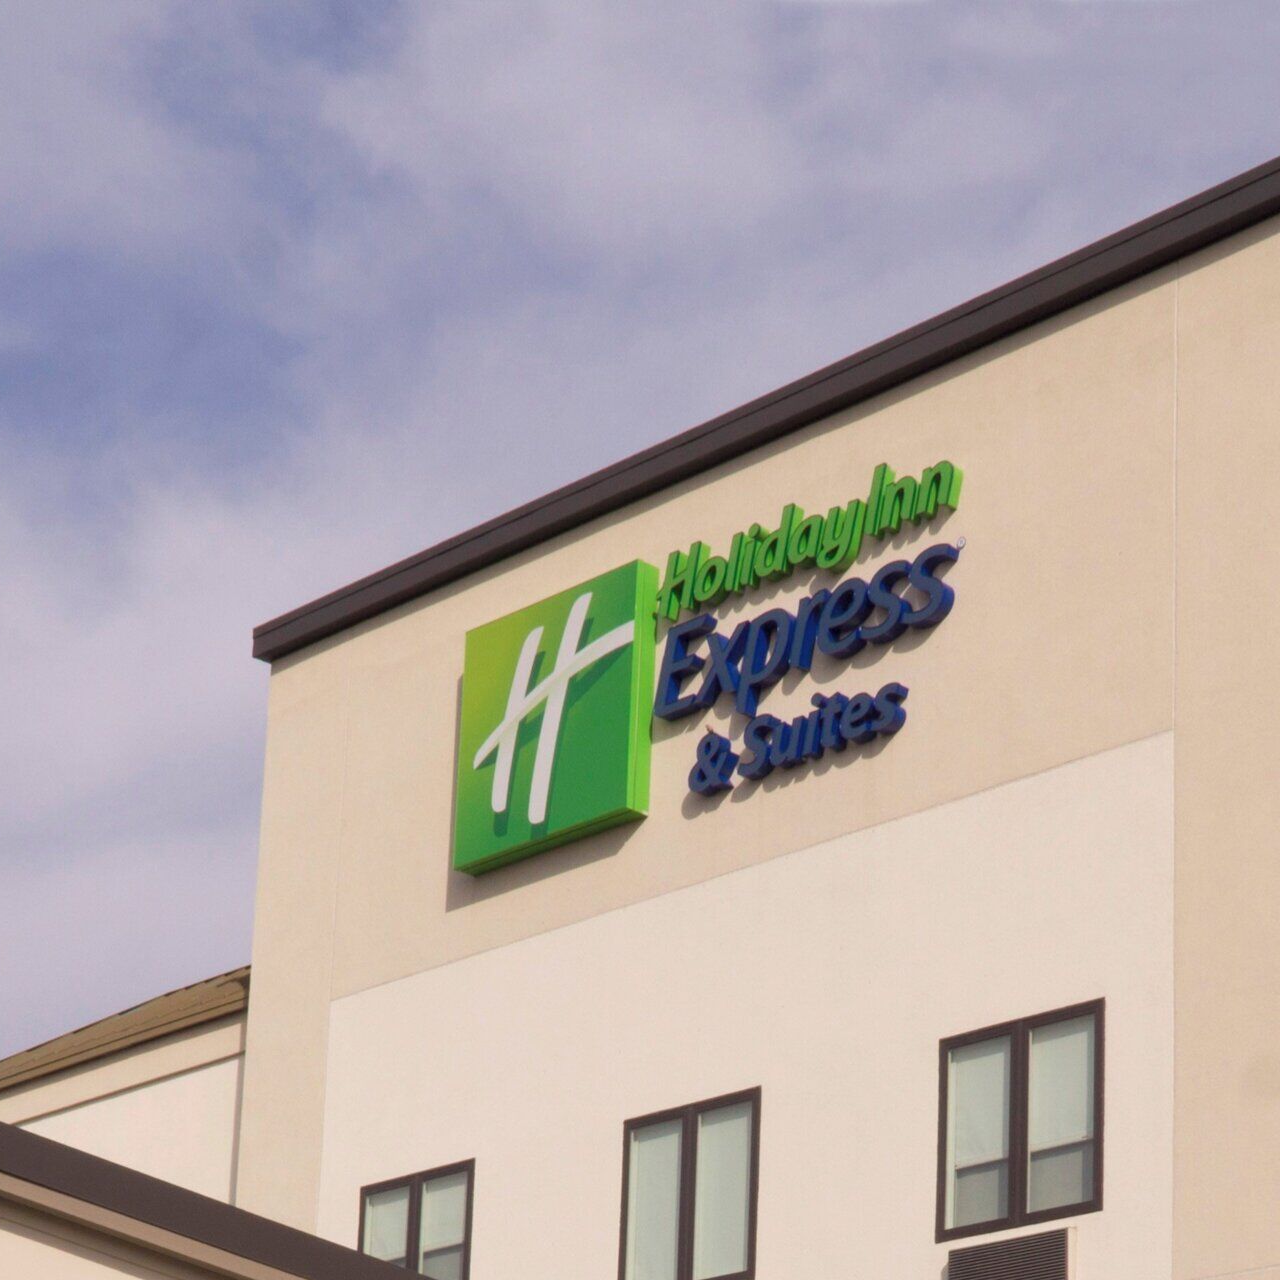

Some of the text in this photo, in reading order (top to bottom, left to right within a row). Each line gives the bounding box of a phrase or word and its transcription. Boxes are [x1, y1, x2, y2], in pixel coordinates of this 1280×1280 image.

[652, 460, 963, 621] Holiday Inn
[654, 543, 955, 720] Express
[688, 682, 909, 796] & Suites
